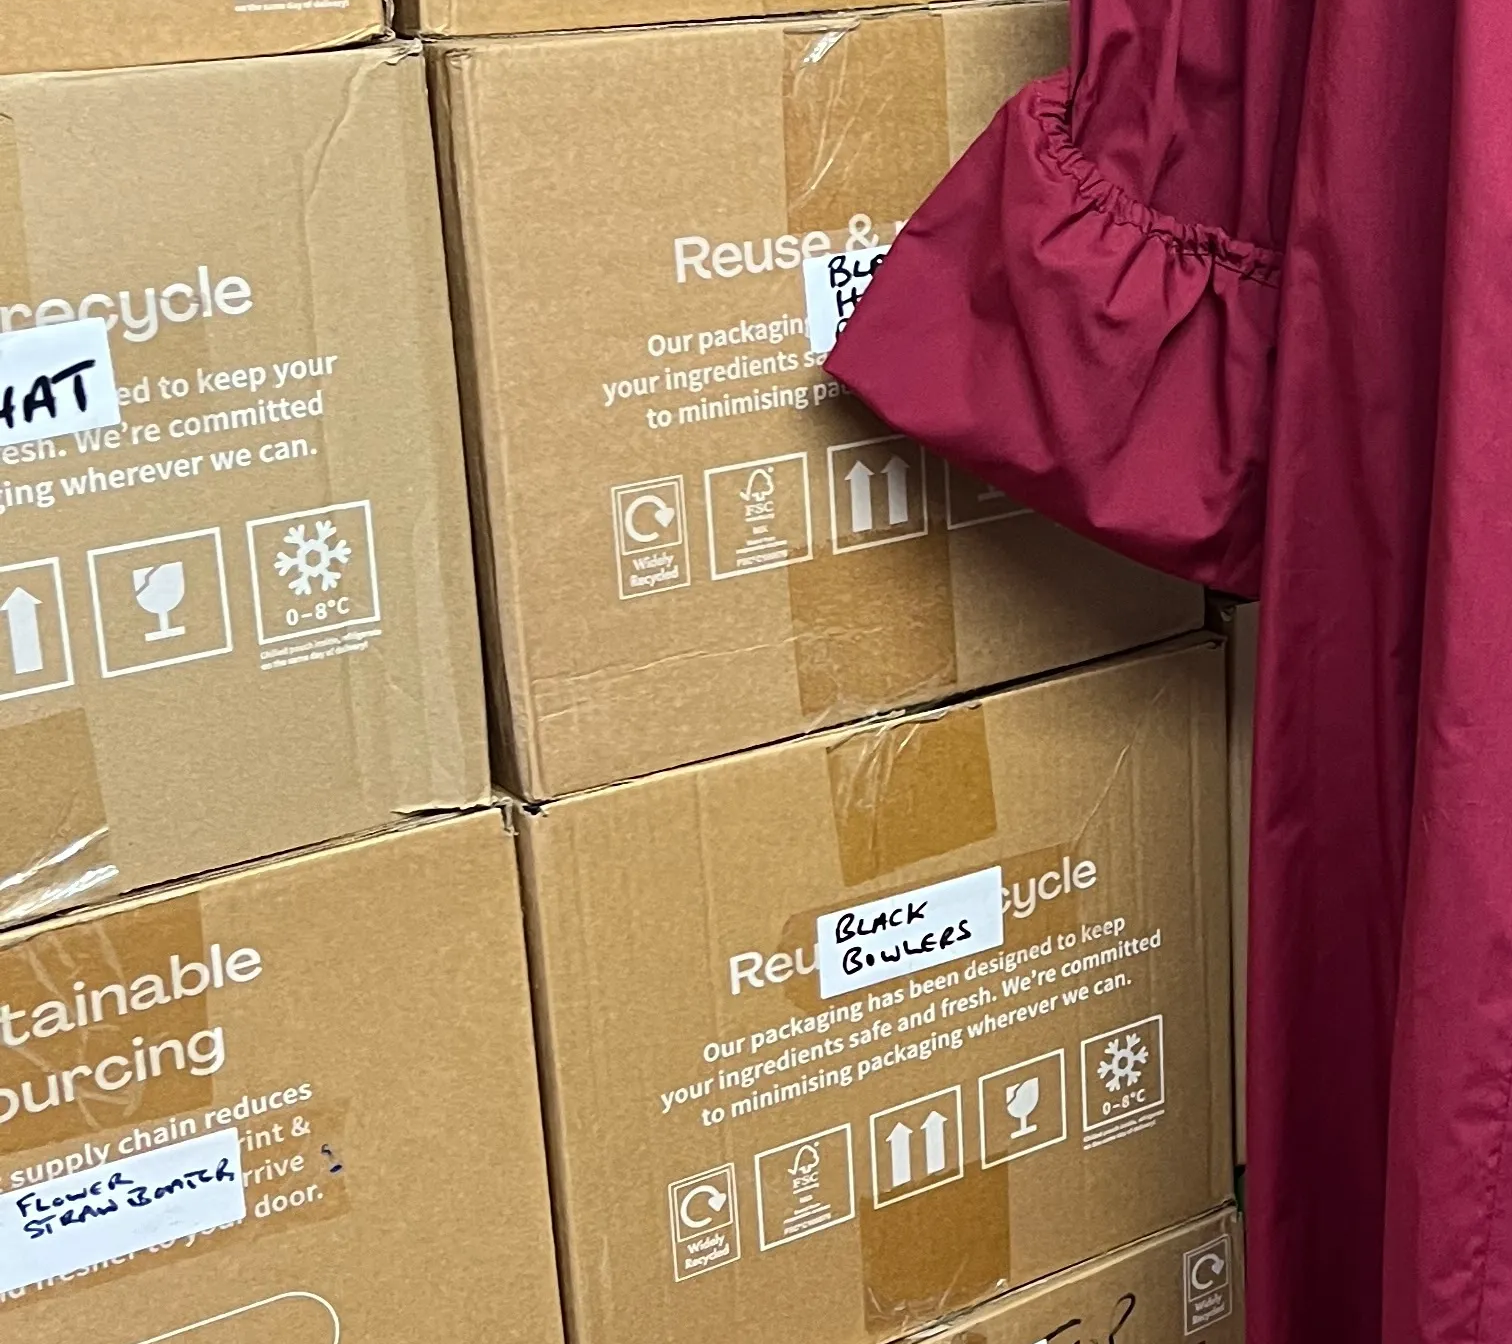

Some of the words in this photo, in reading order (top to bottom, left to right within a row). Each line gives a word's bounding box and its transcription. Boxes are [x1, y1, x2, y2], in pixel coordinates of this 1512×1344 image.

[674, 231, 831, 284] Reuse
[845, 213, 879, 250] &
[0, 265, 254, 343] recycle
[648, 332, 693, 357] Our
[157, 377, 188, 398] to
[197, 364, 266, 394] keep
[273, 355, 337, 389] your
[602, 375, 664, 406] your
[665, 351, 798, 393] ingredients
[169, 390, 323, 437] committed
[646, 407, 671, 429] to
[679, 386, 808, 424] minimising
[60, 456, 202, 496] wherever
[210, 447, 251, 472] we
[259, 437, 317, 464] can.
[745, 500, 774, 516] FSC
[629, 565, 679, 587] Recycled
[632, 551, 674, 570] Widely
[835, 900, 928, 944] BLACK
[842, 919, 972, 975] BOWLERS
[703, 1037, 746, 1062] Our
[751, 1001, 864, 1053] packaging
[868, 987, 904, 1012] has
[909, 970, 959, 1000] been
[964, 936, 1052, 981] designed
[1057, 933, 1076, 951] to
[1082, 917, 1126, 943] keep
[661, 1078, 714, 1113] your
[719, 1036, 844, 1090] ingredients
[849, 1020, 893, 1048] safe
[897, 1003, 935, 1033] and
[940, 985, 997, 1018] fresh.
[1061, 928, 1161, 977] committed
[701, 1108, 725, 1126] to
[731, 1064, 853, 1118] minimising
[857, 1029, 963, 1080] packaging
[967, 995, 1059, 1039] wherever
[1062, 985, 1089, 1006] we
[1093, 972, 1132, 996] can.
[10, 1142, 110, 1190] supply
[117, 1118, 197, 1155] chain
[203, 1083, 313, 1130] reduces
[291, 1116, 311, 1136] &
[16, 1172, 133, 1217] FLOWER
[254, 1183, 324, 1218] door.
[792, 1172, 819, 1188] FSC
[23, 1199, 118, 1239] STRAW
[685, 1243, 730, 1270] Recycled
[687, 1233, 725, 1254] Widely
